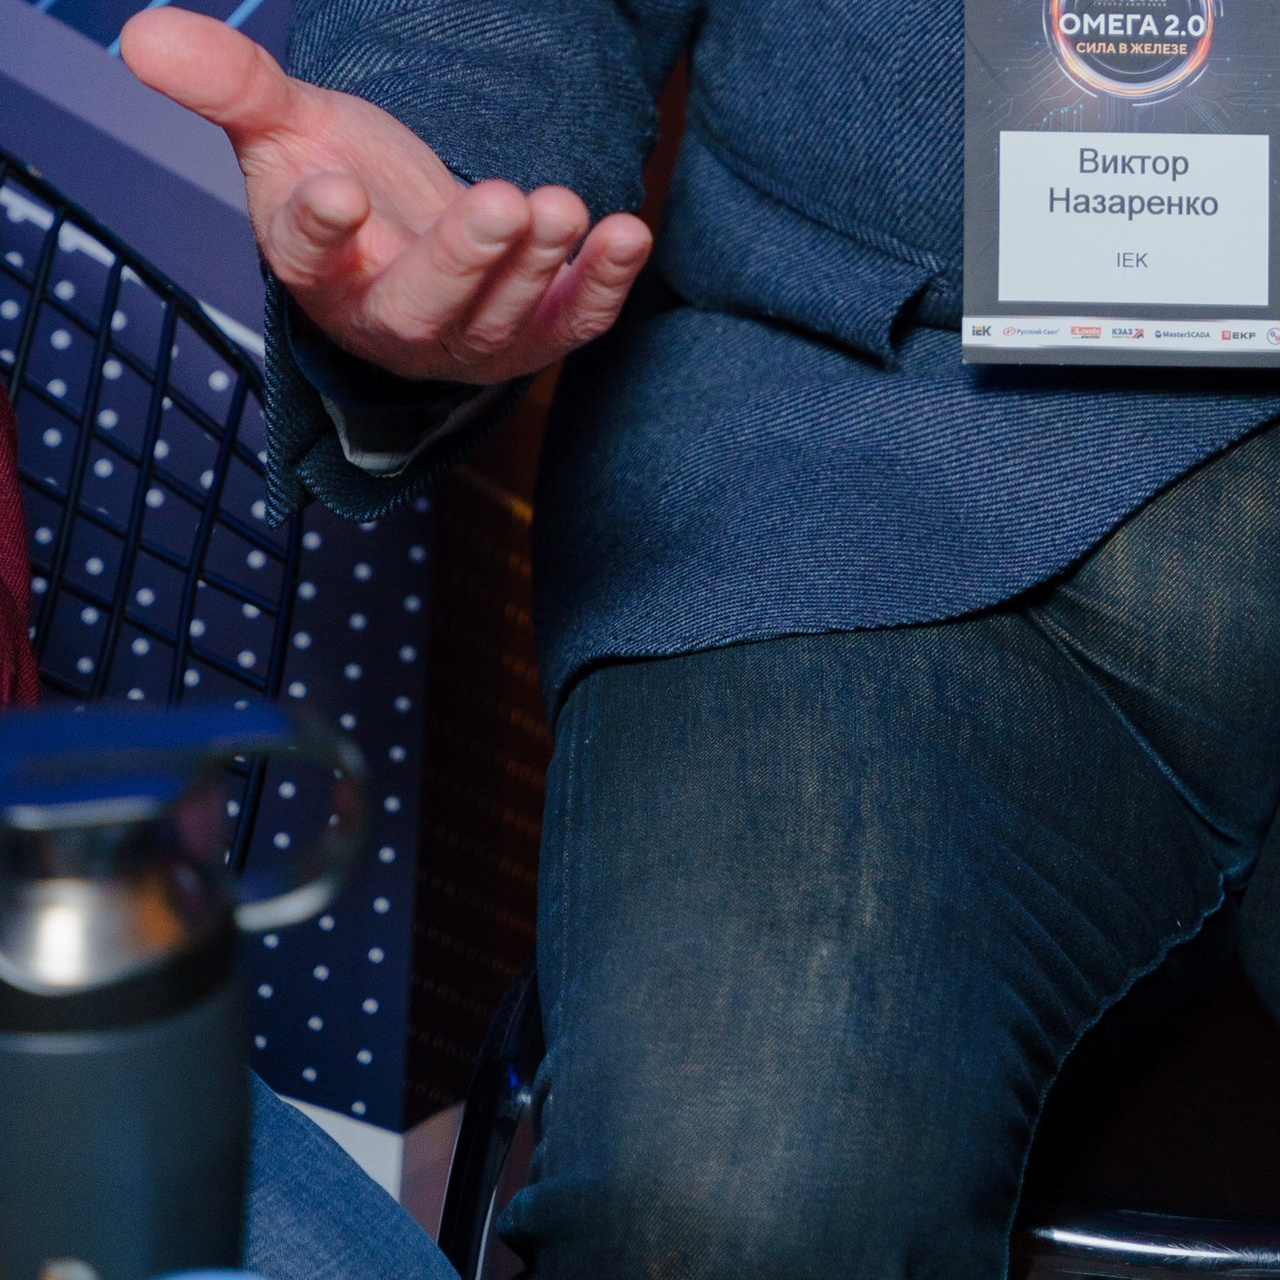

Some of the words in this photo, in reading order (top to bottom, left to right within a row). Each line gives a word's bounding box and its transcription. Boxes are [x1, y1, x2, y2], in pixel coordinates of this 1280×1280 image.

[1058, 13, 1158, 36] ОМЕГА
[1164, 14, 1205, 37] 2.0
[1076, 42, 1116, 54] СИЛА
[1119, 43, 1127, 54] В
[1130, 43, 1188, 55] ЖЕЛЕЗЕ
[1079, 147, 1189, 182] Виктор
[1049, 187, 1219, 221] Назаренко
[1117, 252, 1148, 268] IEK
[1017, 328, 1042, 336] Русский
[1112, 328, 1133, 336] КЭАЗ
[1163, 330, 1211, 339] MasterSCADA
[1232, 331, 1256, 340] EKF
